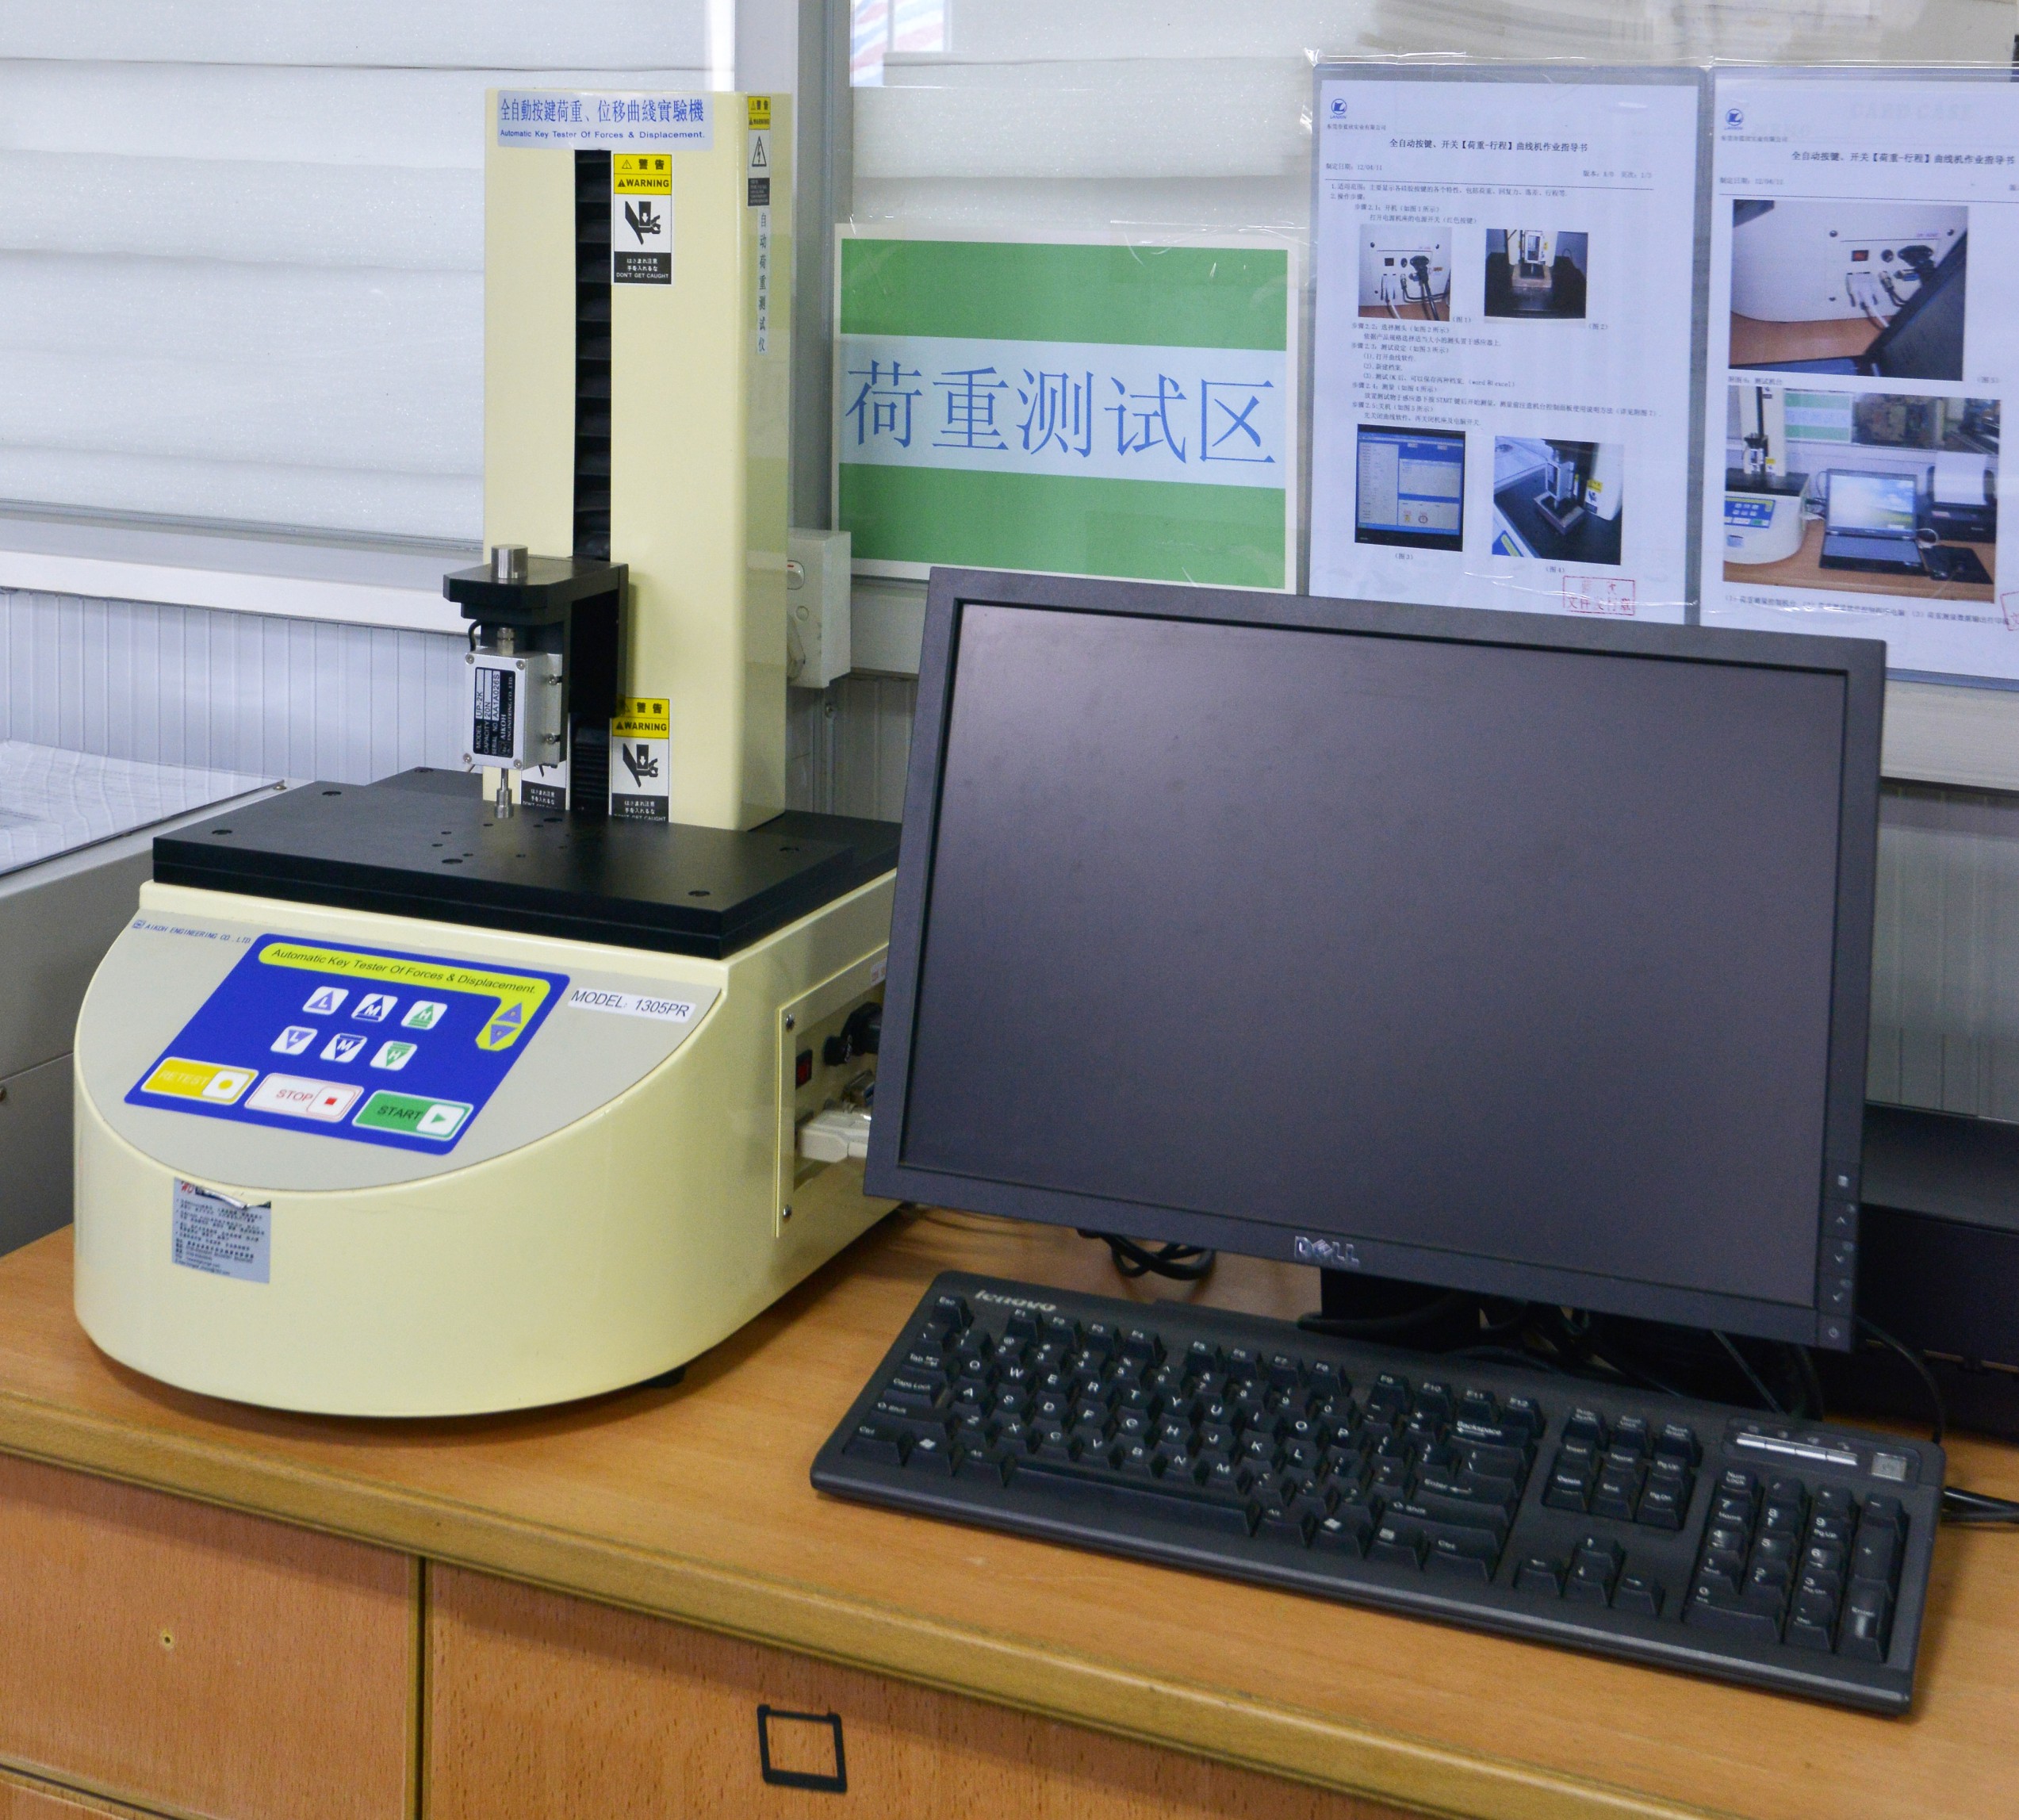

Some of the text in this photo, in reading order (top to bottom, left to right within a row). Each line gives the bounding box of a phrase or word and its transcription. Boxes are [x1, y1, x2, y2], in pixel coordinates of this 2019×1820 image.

[500, 129, 532, 138] Automatic
[639, 131, 706, 140] Displacement.
[626, 178, 669, 188] WARNING
[845, 360, 1276, 464] 荷重测试区
[624, 721, 667, 731] WARNING
[145, 924, 168, 933] AIKOH
[170, 926, 218, 939] ENGINEERING
[272, 948, 537, 994] Automatic Key Tester Of Forces & Displacement.
[318, 997, 328, 1008] L
[635, 998, 690, 1017] 1305PR
[364, 1005, 381, 1016] M
[419, 1010, 431, 1020] H
[289, 1032, 299, 1041] L
[338, 1040, 351, 1051] M
[388, 1050, 400, 1060] H
[159, 1069, 209, 1086] RETEST
[276, 1089, 314, 1102] STOP
[376, 1105, 422, 1121] START
[1294, 1236, 1359, 1267] DELL
[975, 1289, 1056, 1312] lenovo
[910, 1353, 923, 1363] Tab
[969, 1360, 980, 1370] Q
[1010, 1366, 1025, 1378] W
[893, 1377, 912, 1388] Caps
[1048, 1374, 1059, 1385] E
[963, 1388, 974, 1398] A
[1088, 1382, 1099, 1393] R
[1003, 1394, 1014, 1405] S
[1131, 1389, 1140, 1400] T
[1044, 1401, 1055, 1412] D
[1172, 1396, 1182, 1408] Y
[1082, 1408, 1095, 1420] F
[1210, 1404, 1223, 1416] U
[967, 1415, 980, 1425] Z
[1126, 1418, 1139, 1428] G
[1295, 1420, 1308, 1431] O
[1009, 1423, 1021, 1434] X
[1167, 1425, 1179, 1437] H
[1337, 1427, 1349, 1438] P
[1457, 1420, 1503, 1436] Backspace
[1050, 1431, 1061, 1442] C
[1209, 1434, 1219, 1444] J
[1093, 1438, 1103, 1449] V
[1251, 1441, 1262, 1452] K
[1565, 1444, 1586, 1454] Insert
[1132, 1446, 1143, 1457] B
[1293, 1449, 1302, 1460] L
[1174, 1455, 1186, 1466] N
[1611, 1453, 1634, 1463] Home
[1216, 1463, 1230, 1474] M
[1557, 1474, 1581, 1485] Delete
[1727, 1471, 1745, 1481] Num
[1424, 1477, 1448, 1490] Enter
[1603, 1483, 1619, 1492] End
[1722, 1499, 1731, 1509] 7
[1768, 1508, 1778, 1519] 8
[1815, 1517, 1826, 1527] 9
[1714, 1530, 1722, 1538] 4
[1761, 1538, 1772, 1547] 5
[1811, 1548, 1821, 1558] 6
[1805, 1577, 1815, 1586] 3
[1699, 1587, 1711, 1596] 0
